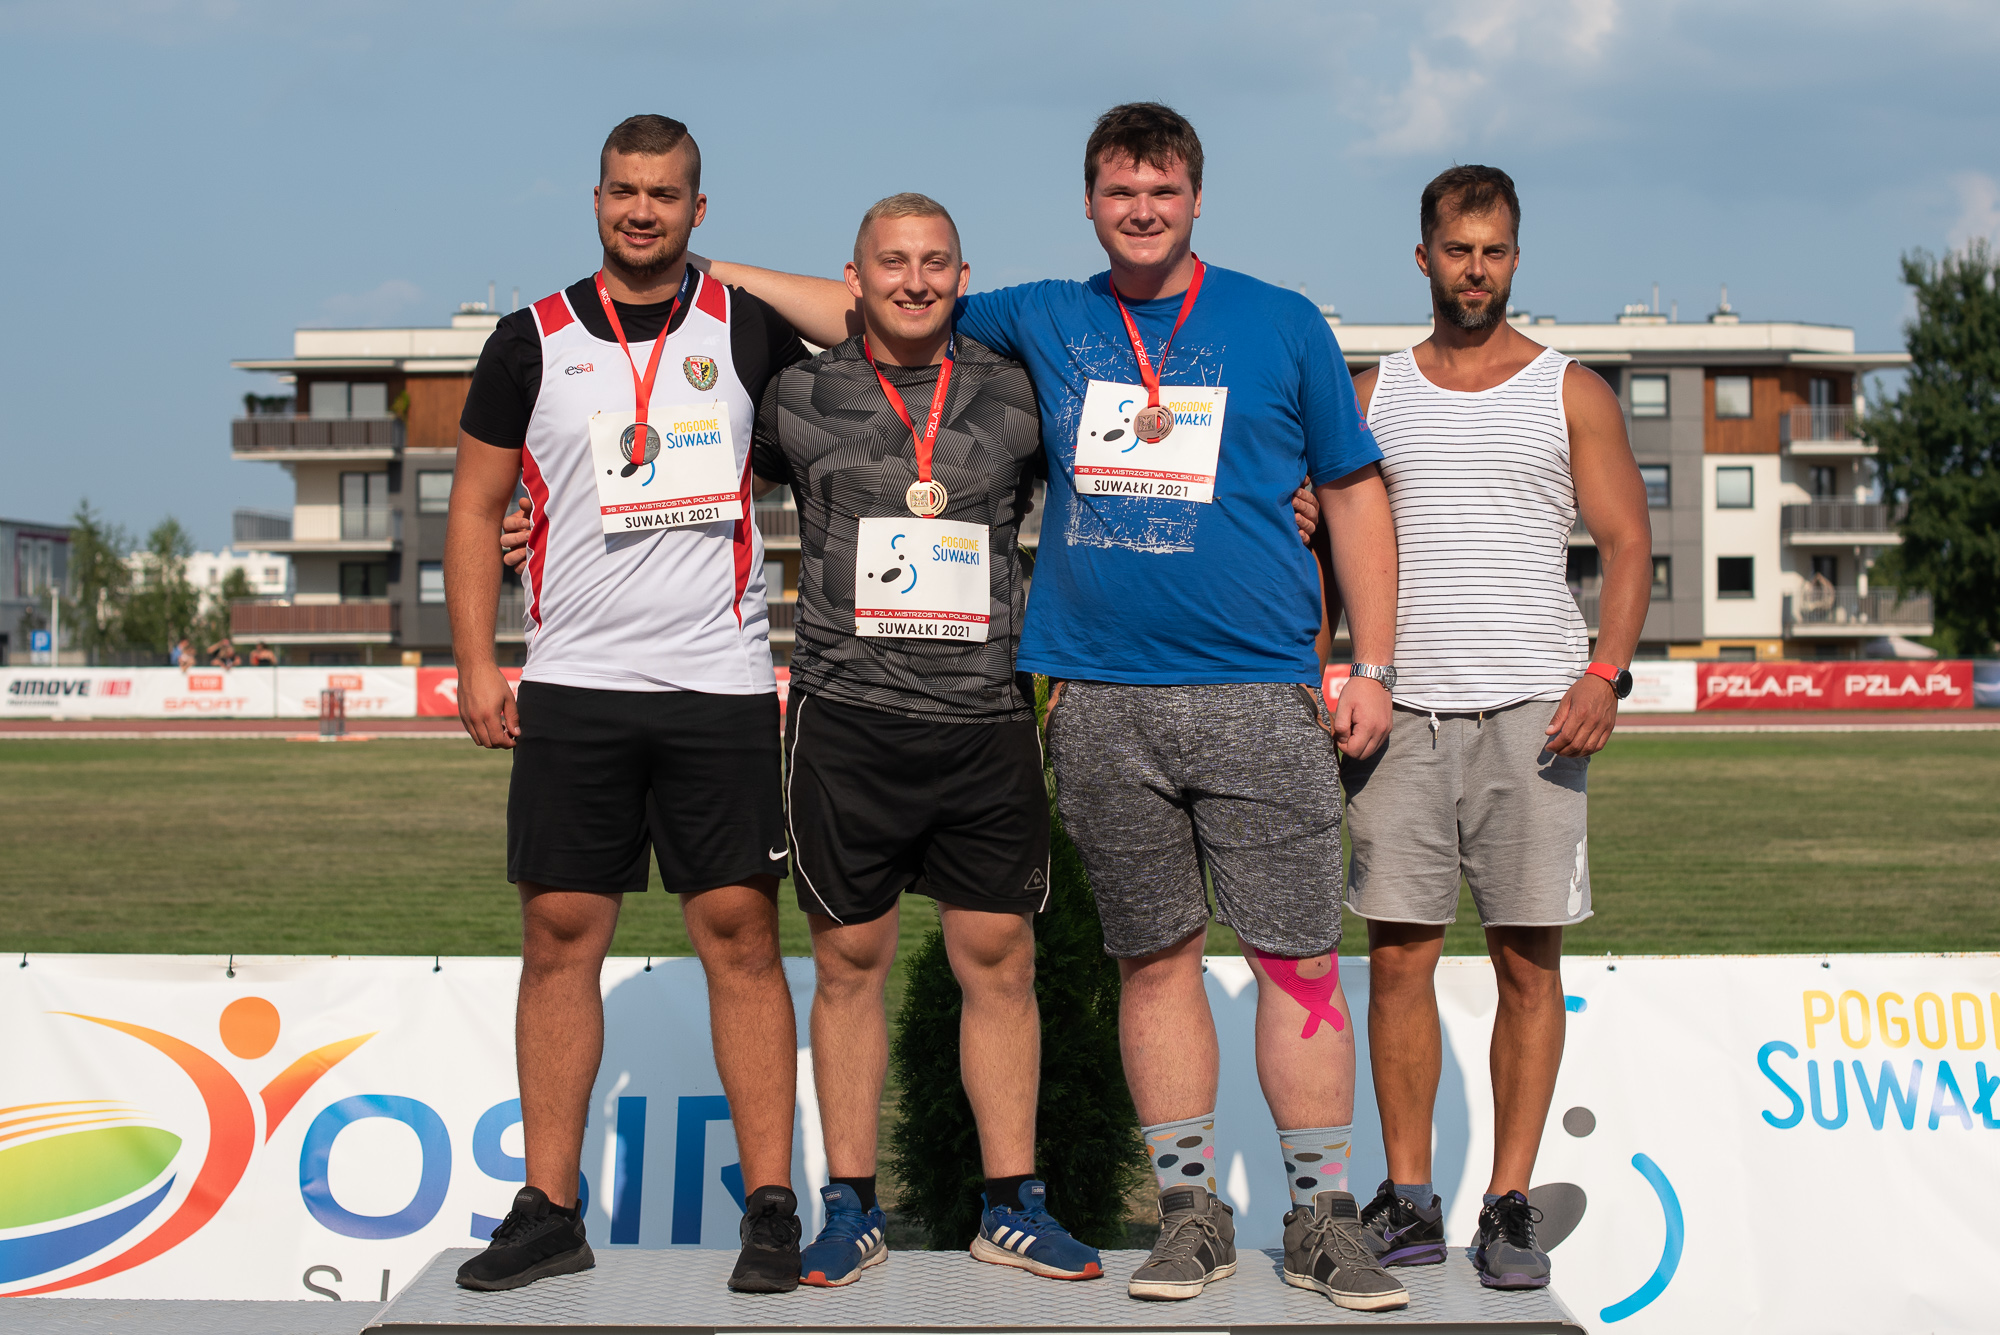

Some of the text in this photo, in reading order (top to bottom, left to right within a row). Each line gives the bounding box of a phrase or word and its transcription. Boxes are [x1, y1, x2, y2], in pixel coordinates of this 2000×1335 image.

[1134, 340, 1148, 366] PZLA
[1169, 402, 1214, 412] POGODNE
[674, 418, 720, 434] POGODNE
[927, 412, 940, 438] PZLA
[1174, 413, 1212, 426] WAŁKI
[666, 431, 722, 449] SUWAŁKI
[1112, 469, 1165, 478] MISTRZOSTWA
[1166, 472, 1192, 480] POLSKI
[1094, 480, 1188, 497] SUWAŁKI 2021
[639, 499, 692, 510] MISTRZOSTWA
[693, 496, 719, 504] POLSKI
[625, 508, 720, 528] SUWAŁKI 2021
[942, 536, 979, 552] POGODNE
[932, 544, 980, 566] SUWAŁKI
[878, 622, 970, 637] SUWAŁKI 2021
[1707, 676, 1823, 697] PZLA.PL
[1845, 674, 1962, 696] PZLA.PL
[164, 696, 248, 712] SPORT
